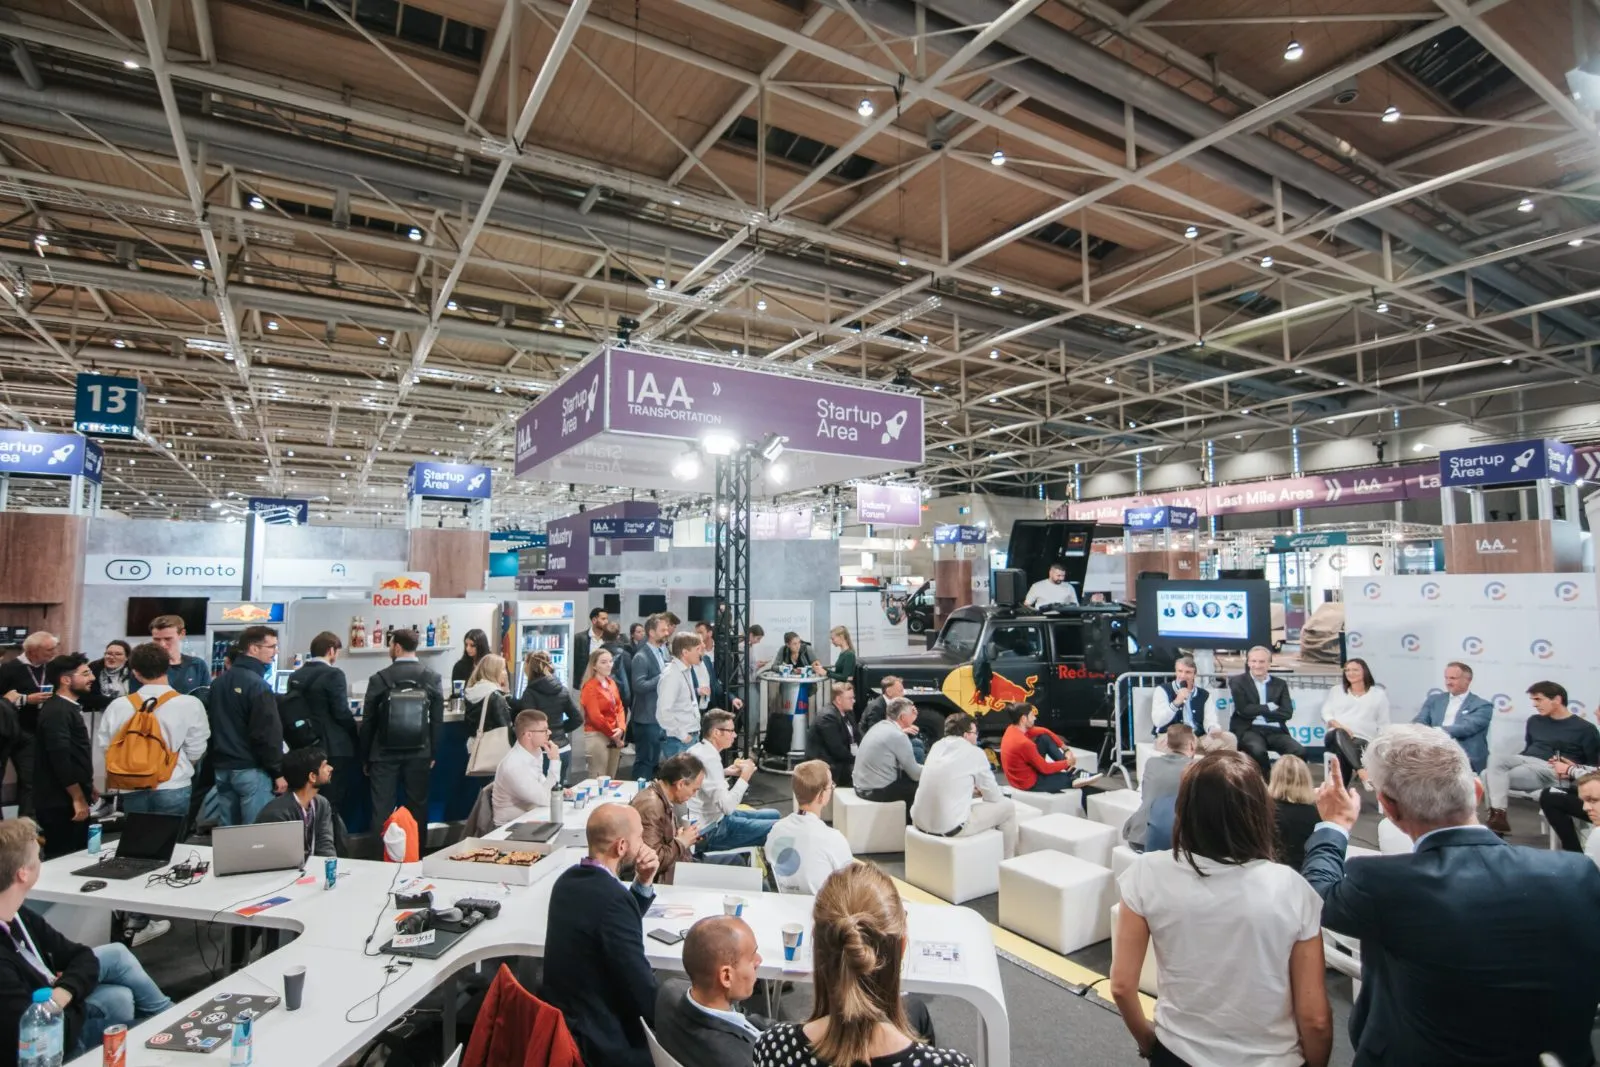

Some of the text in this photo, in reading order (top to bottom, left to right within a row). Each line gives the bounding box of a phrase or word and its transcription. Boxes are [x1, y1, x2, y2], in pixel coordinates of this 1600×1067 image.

[627, 369, 694, 410] IAA
[87, 384, 127, 414] 13
[562, 389, 588, 417] Startup
[627, 403, 722, 425] TRANSPORTATION
[816, 398, 882, 430] Startup
[561, 415, 577, 437] Area
[816, 418, 858, 441] Area
[517, 424, 532, 454] IAA
[1449, 454, 1505, 469] Startup
[423, 469, 465, 483] Startup
[1450, 467, 1485, 479] Area
[423, 478, 450, 490] Area
[1353, 478, 1382, 492] IAA
[1215, 487, 1314, 508] Last Mile Area
[861, 499, 892, 513] Industry
[1096, 506, 1118, 519] Mile
[861, 509, 886, 519] Forum
[593, 522, 609, 531] IAA
[623, 521, 645, 530] Startup
[549, 527, 573, 548] Industry
[1475, 538, 1505, 552] IAA
[166, 562, 236, 576] iomoto
[548, 553, 566, 571] Forum
[373, 594, 428, 606] Red Bull
[1058, 663, 1087, 680] Red
